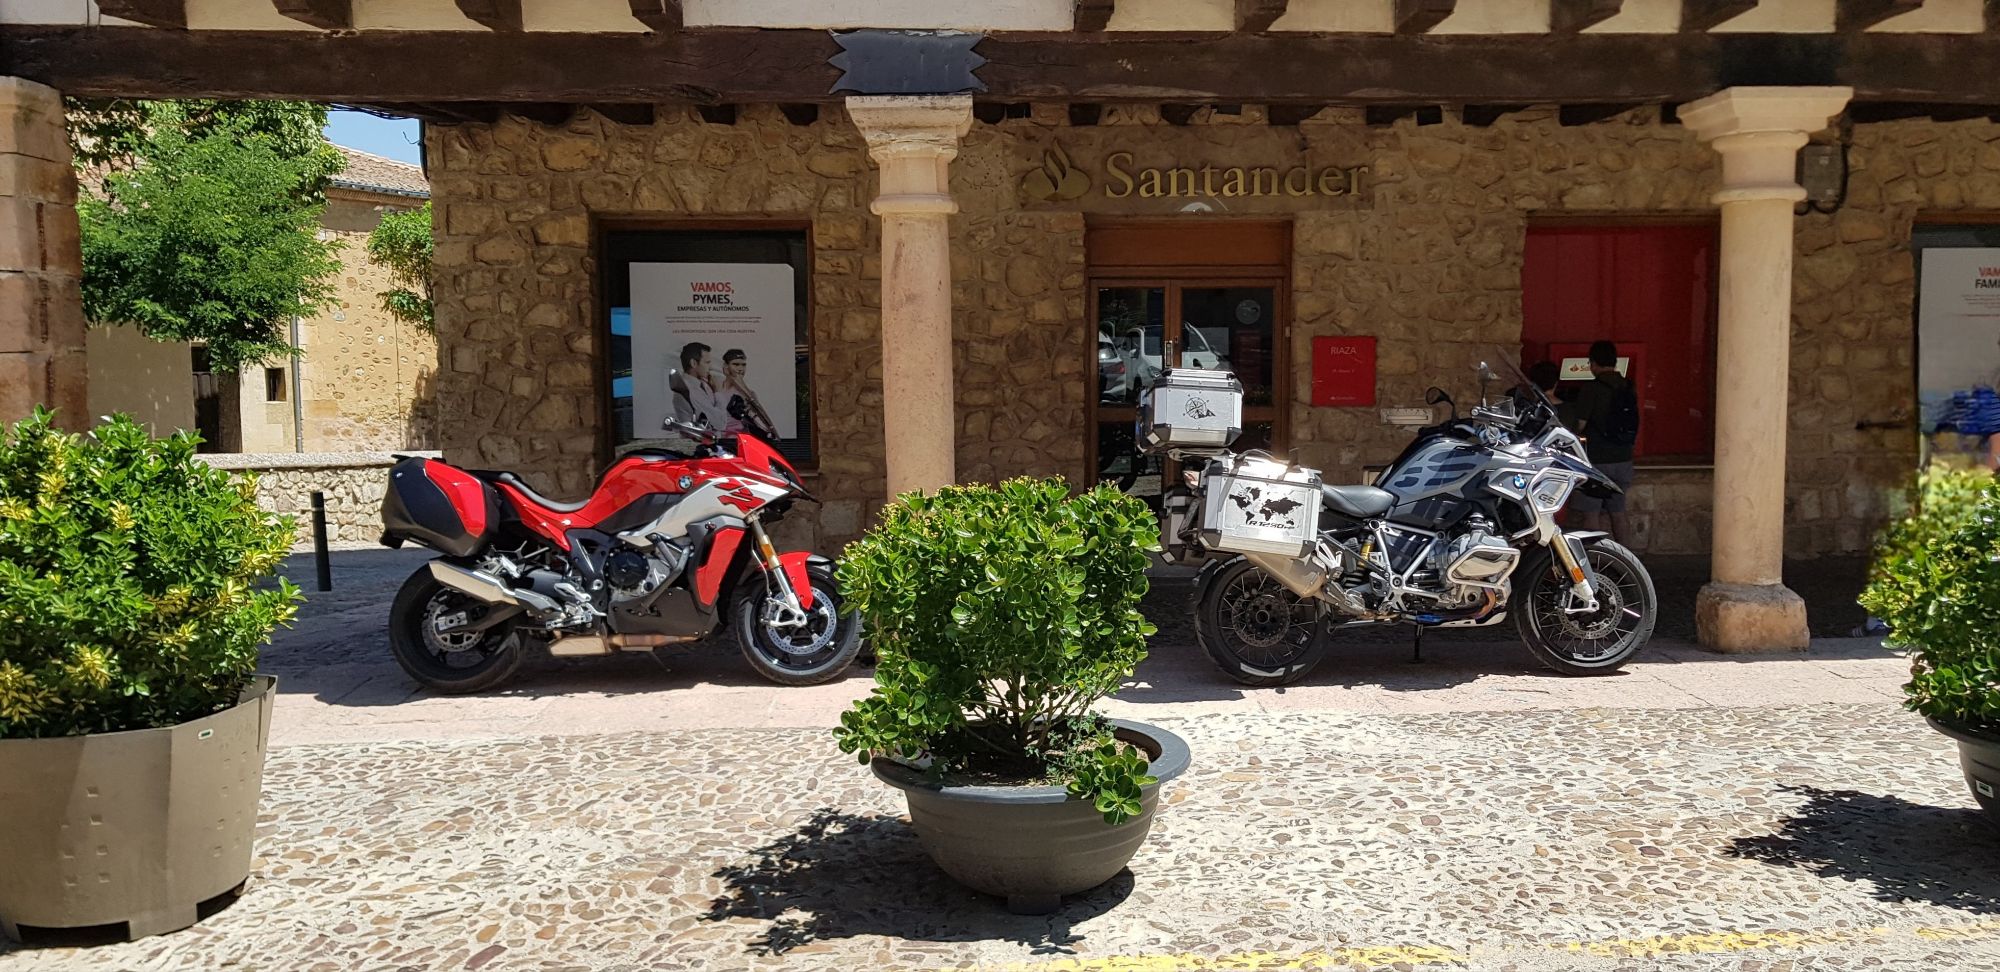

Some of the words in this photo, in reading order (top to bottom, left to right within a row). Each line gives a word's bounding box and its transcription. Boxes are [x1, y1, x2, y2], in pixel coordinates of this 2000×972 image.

[1105, 152, 1369, 199] Santander
[690, 282, 734, 294] VAMOS,
[692, 294, 734, 305] PYMES,
[1330, 346, 1357, 355] RIAZA
[1538, 494, 1556, 504] GS
